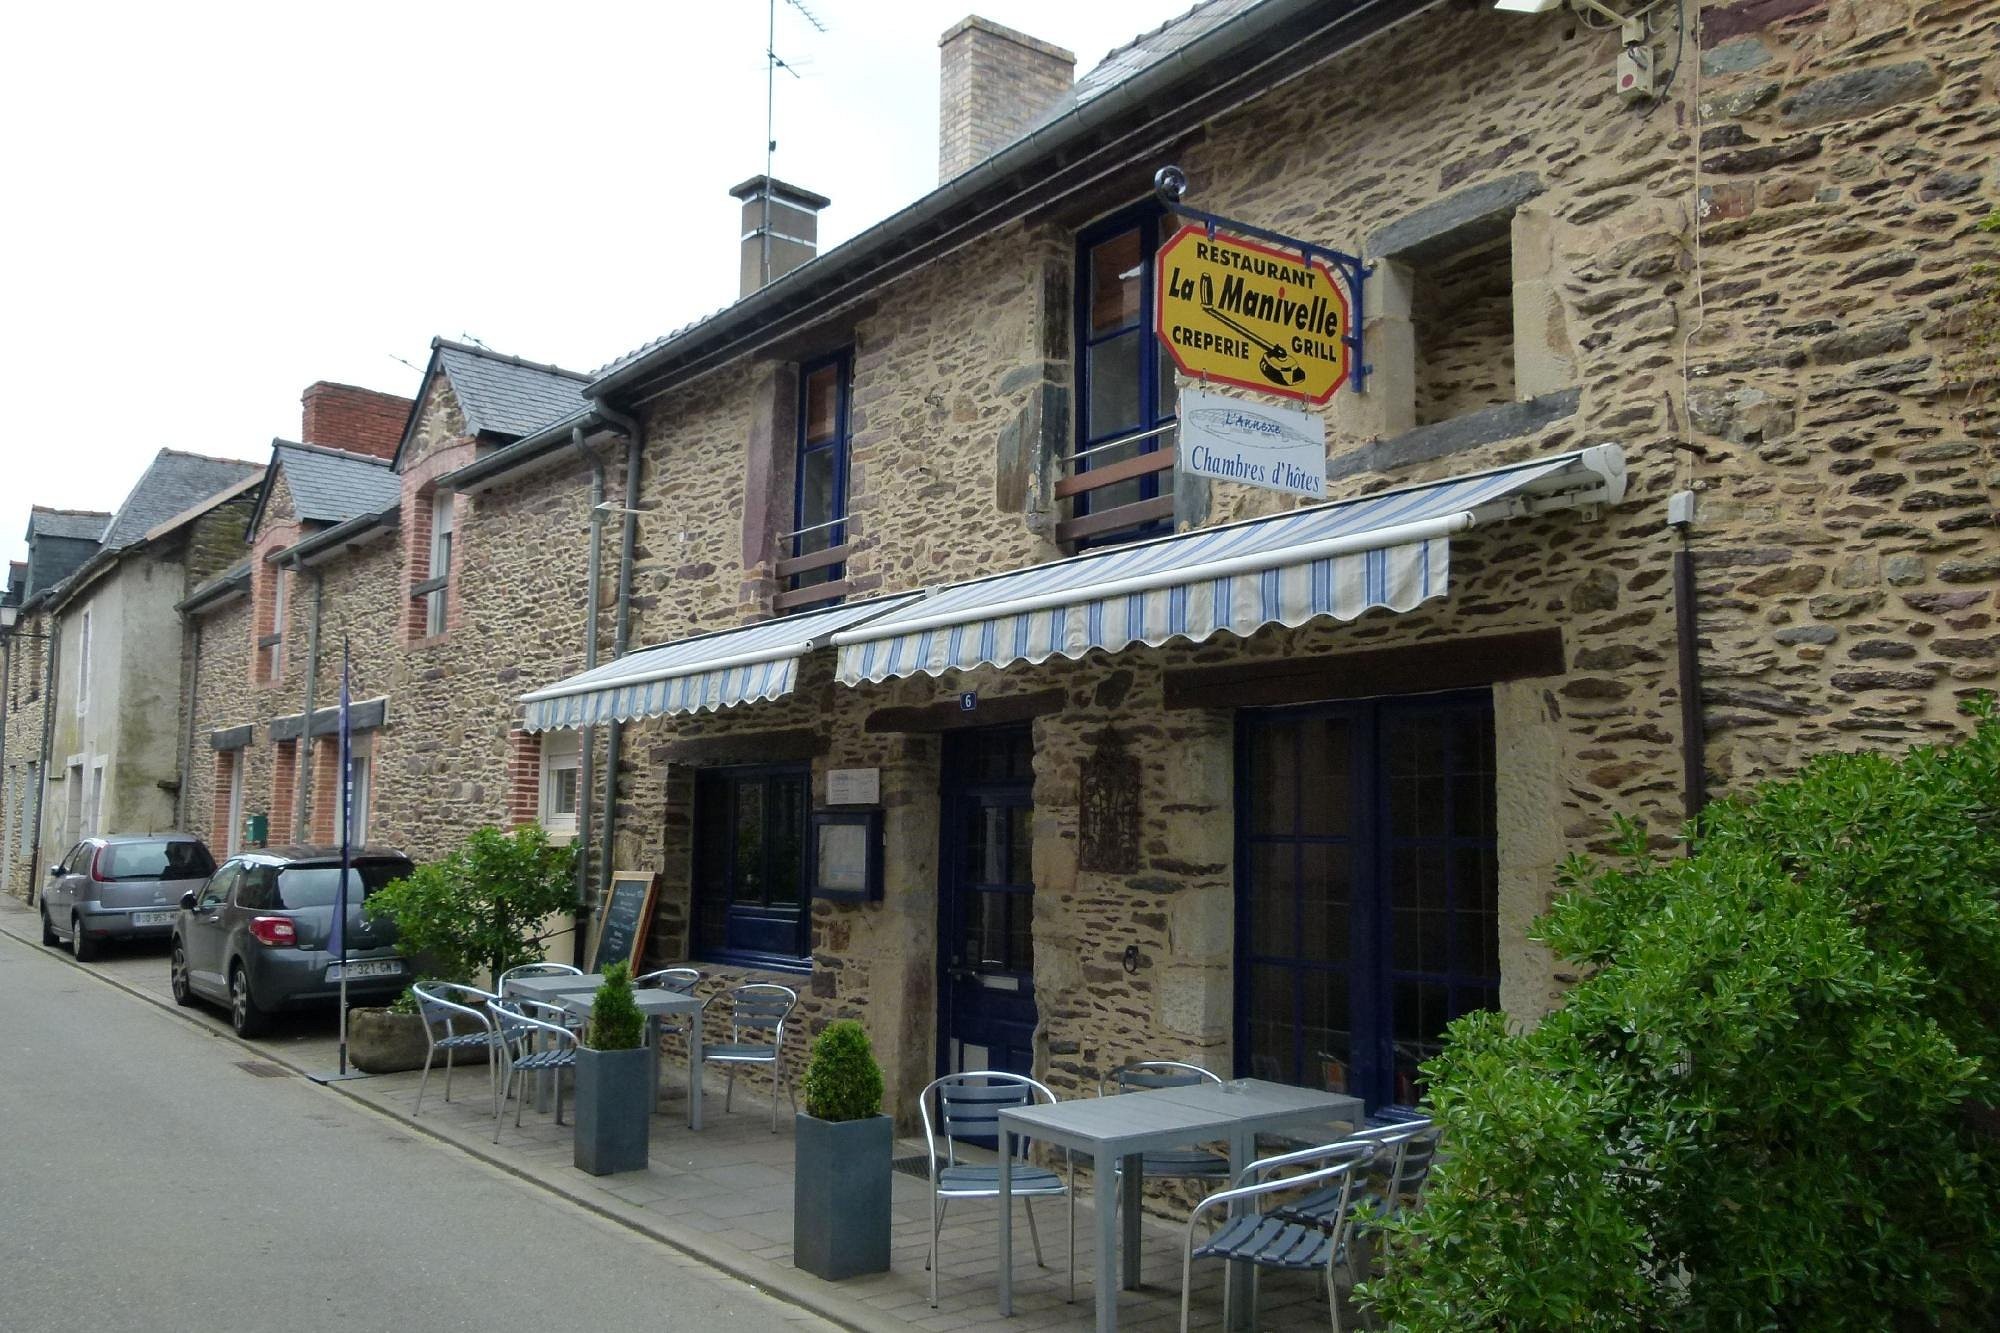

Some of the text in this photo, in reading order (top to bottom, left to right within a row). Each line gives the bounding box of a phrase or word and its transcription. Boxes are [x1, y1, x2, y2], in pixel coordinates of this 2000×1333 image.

[1196, 241, 1315, 290] RESTAURANT
[1168, 267, 1338, 338] La Manivelle
[1172, 325, 1337, 363] CREPERIE GRILL
[1191, 445, 1320, 493] Chambres d'hôtes
[965, 694, 972, 708] 6
